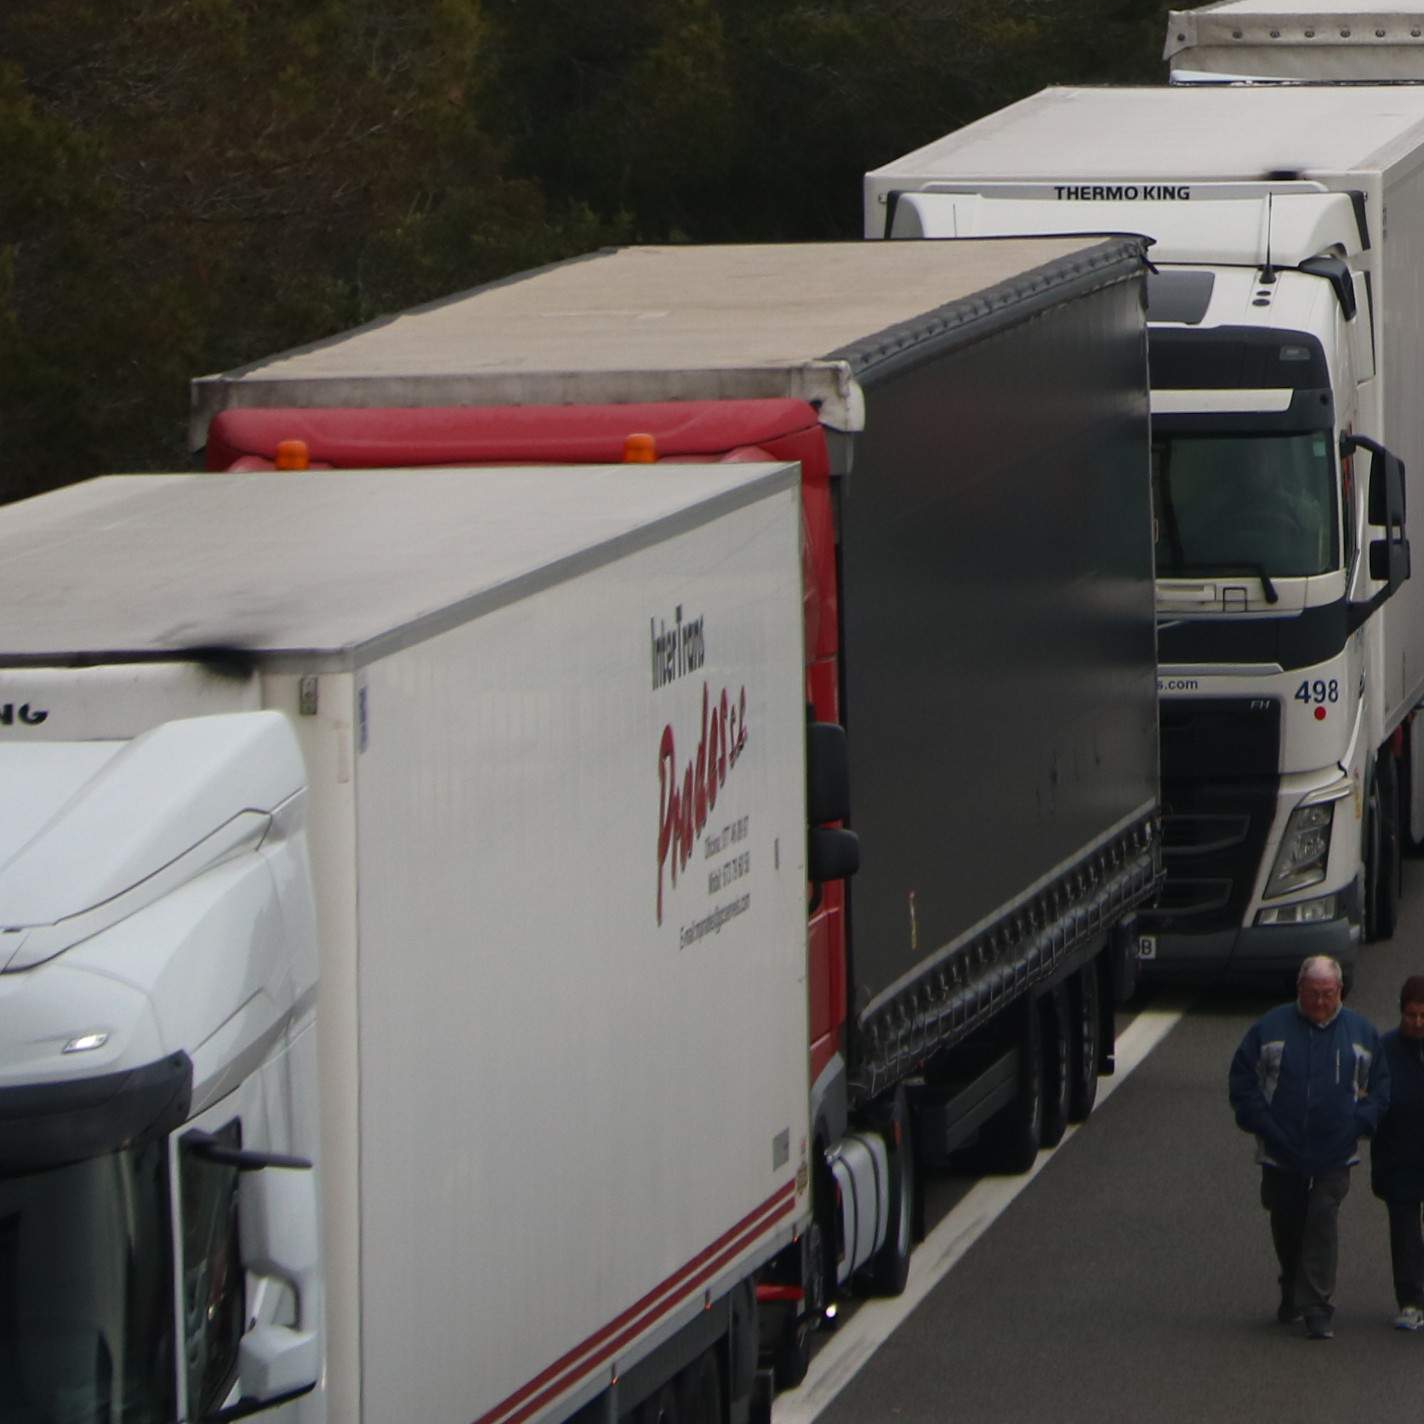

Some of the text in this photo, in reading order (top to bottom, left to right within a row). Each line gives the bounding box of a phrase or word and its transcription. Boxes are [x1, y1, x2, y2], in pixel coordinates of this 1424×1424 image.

[1054, 185, 1190, 201] THERMO KING
[1295, 678, 1339, 704] 498
